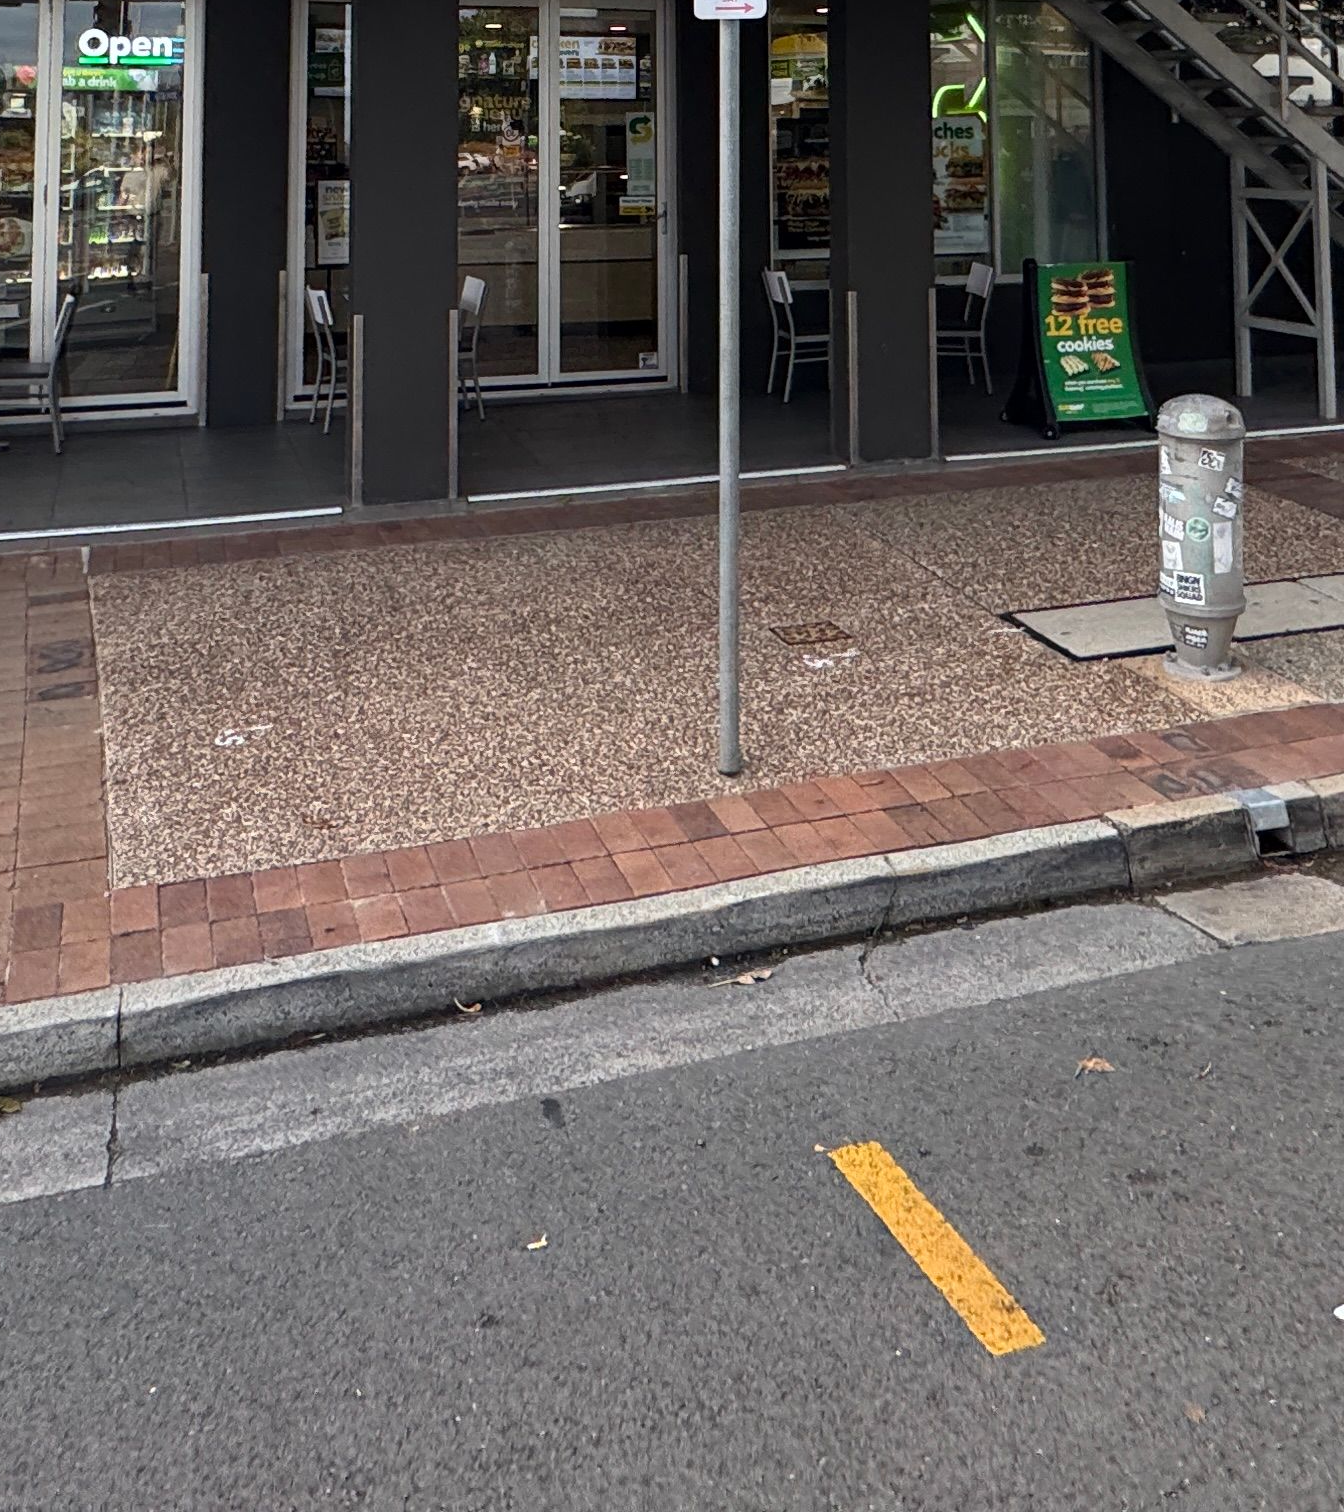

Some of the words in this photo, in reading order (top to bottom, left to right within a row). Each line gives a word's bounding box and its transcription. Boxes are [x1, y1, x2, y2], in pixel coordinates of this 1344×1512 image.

[78, 28, 173, 65] Open
[87, 76, 117, 87] drink
[934, 121, 974, 140] ches
[1045, 315, 1073, 336] 12
[1077, 311, 1123, 335] free
[1057, 336, 1114, 353] cookies
